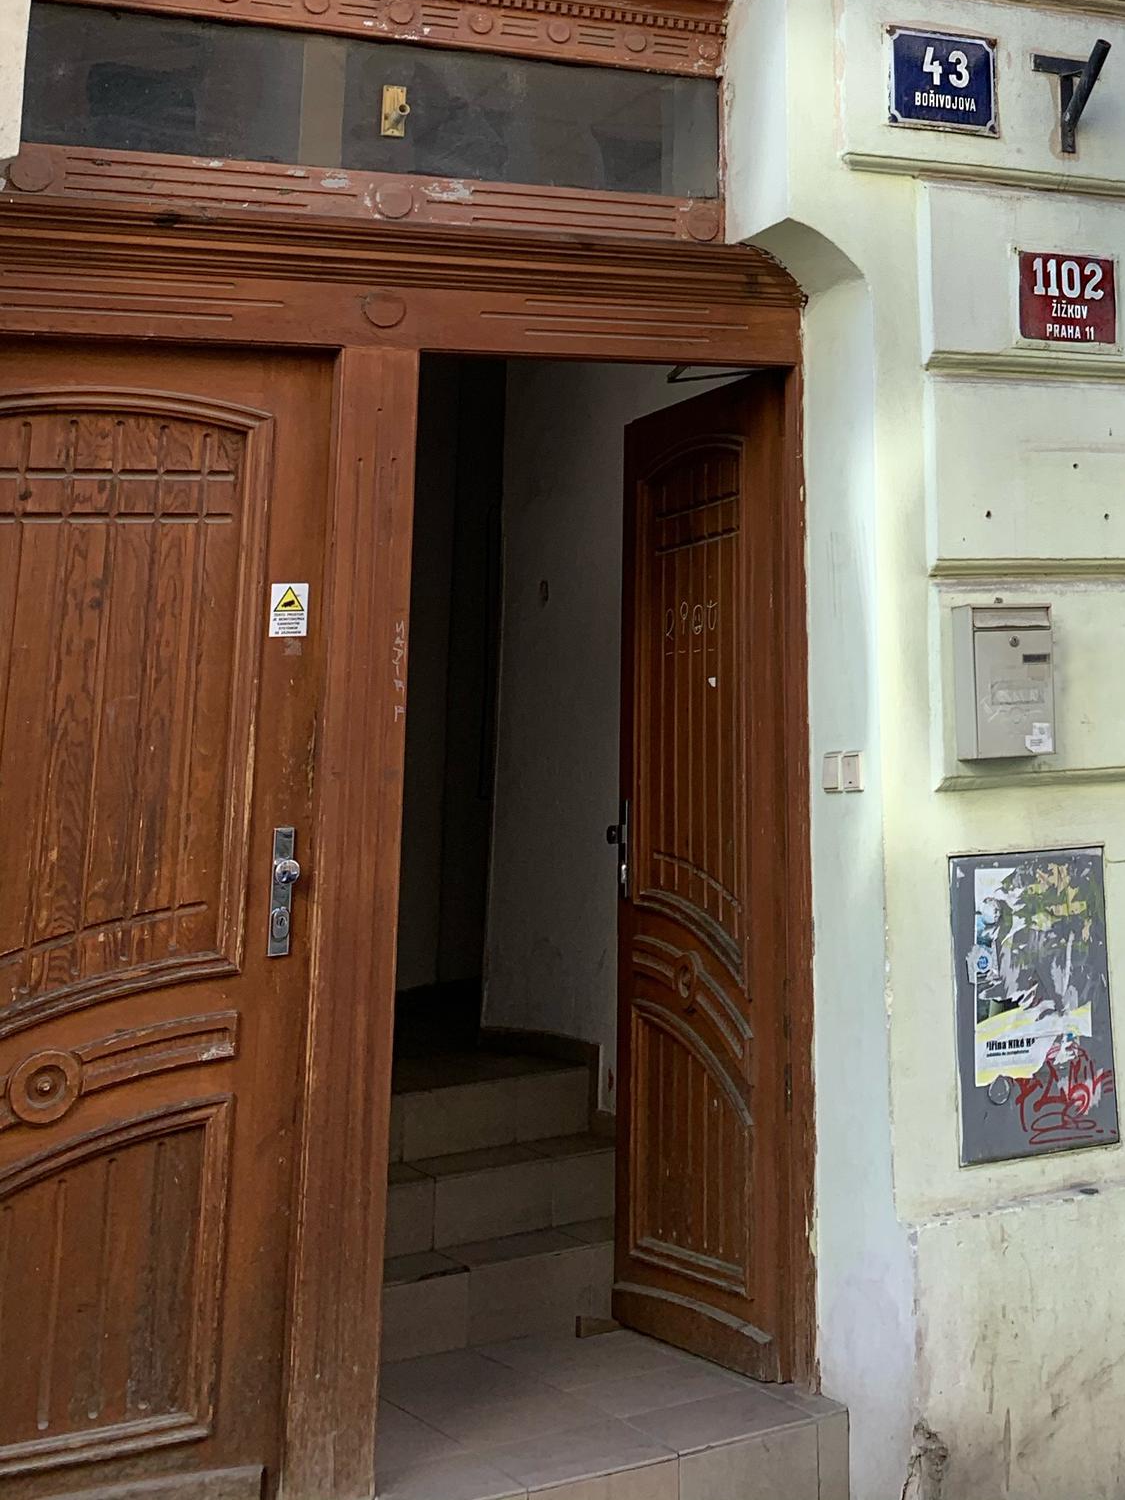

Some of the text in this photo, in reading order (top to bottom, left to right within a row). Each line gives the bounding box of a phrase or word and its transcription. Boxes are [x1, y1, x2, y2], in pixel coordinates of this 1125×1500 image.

[922, 46, 970, 89] 43
[914, 90, 976, 113] BOŘIVOJOVA
[1033, 257, 1104, 301] 1102
[1051, 299, 1088, 320] ŽIŽKOV
[1046, 323, 1095, 340] PRAHA 11
